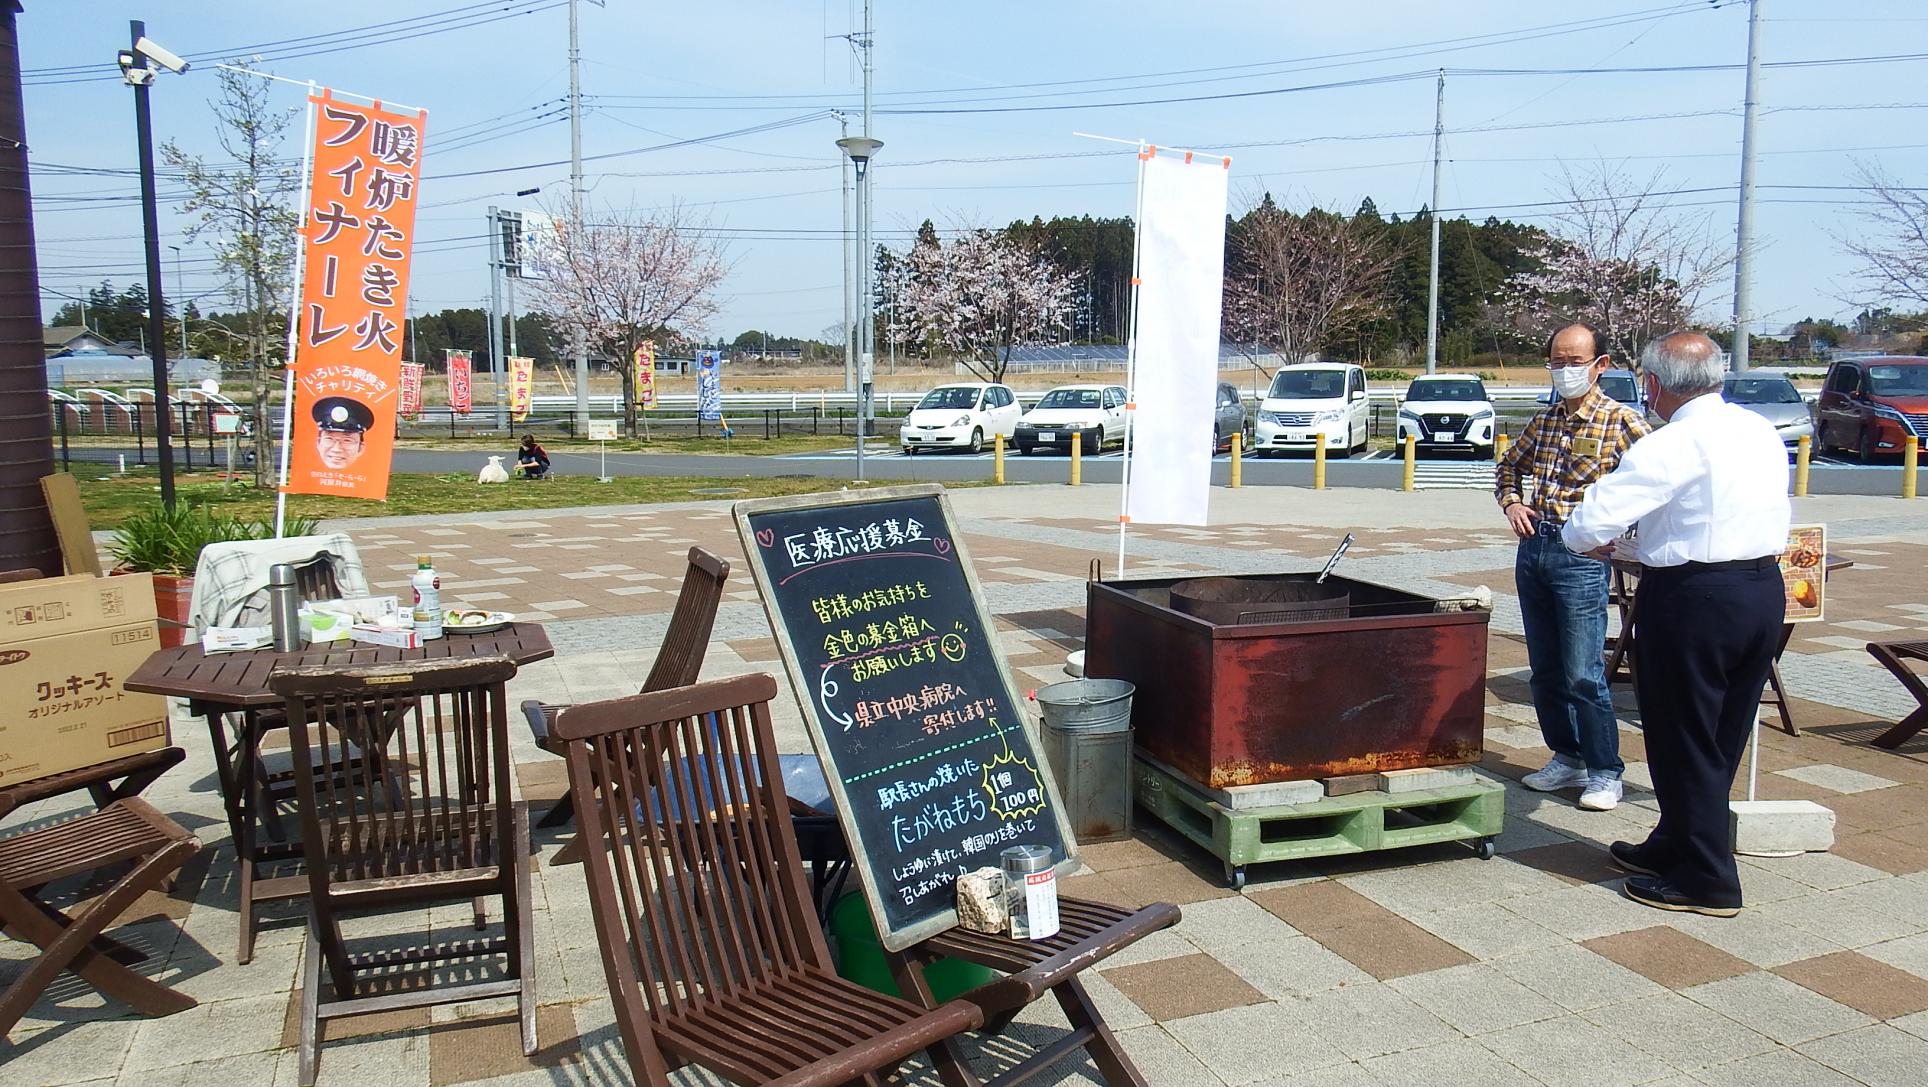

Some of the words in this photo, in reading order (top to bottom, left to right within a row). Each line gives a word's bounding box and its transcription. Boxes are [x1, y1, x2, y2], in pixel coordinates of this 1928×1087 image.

[310, 105, 368, 348] フィナーレ
[353, 120, 418, 354] 暖炉たき火
[315, 379, 377, 399] チャリティ
[784, 517, 932, 568] 医療応援募金
[811, 580, 932, 625] 皆様のお気持ちを
[115, 630, 150, 643] 11514
[823, 614, 936, 660] 金色の募金箱へ
[850, 639, 937, 683] お願いします
[28, 691, 125, 719] オリジナルアソート
[855, 683, 968, 729] 県立中央病院へ
[877, 757, 980, 811] 駅長さんの焼いた
[989, 771, 1014, 796] 1個
[999, 787, 1040, 812] 100円
[891, 788, 987, 854] たがねもち
